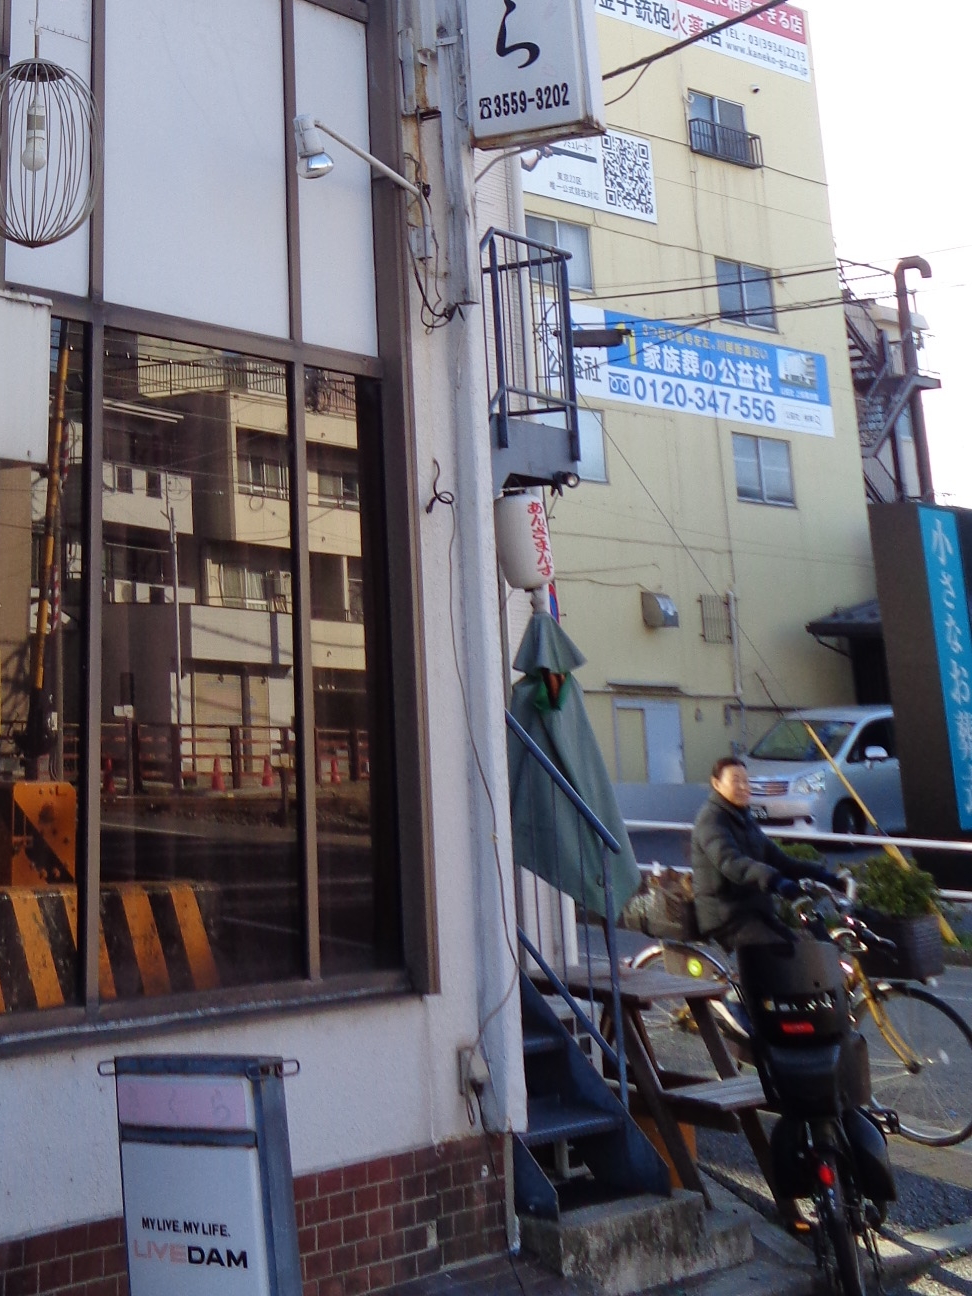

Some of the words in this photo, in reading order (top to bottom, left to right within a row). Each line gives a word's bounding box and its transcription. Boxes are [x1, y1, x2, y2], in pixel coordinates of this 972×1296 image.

[493, 82, 570, 119] 3559-3202
[641, 341, 775, 393] 家族葬の公益社
[633, 375, 776, 424] 0120-347-556
